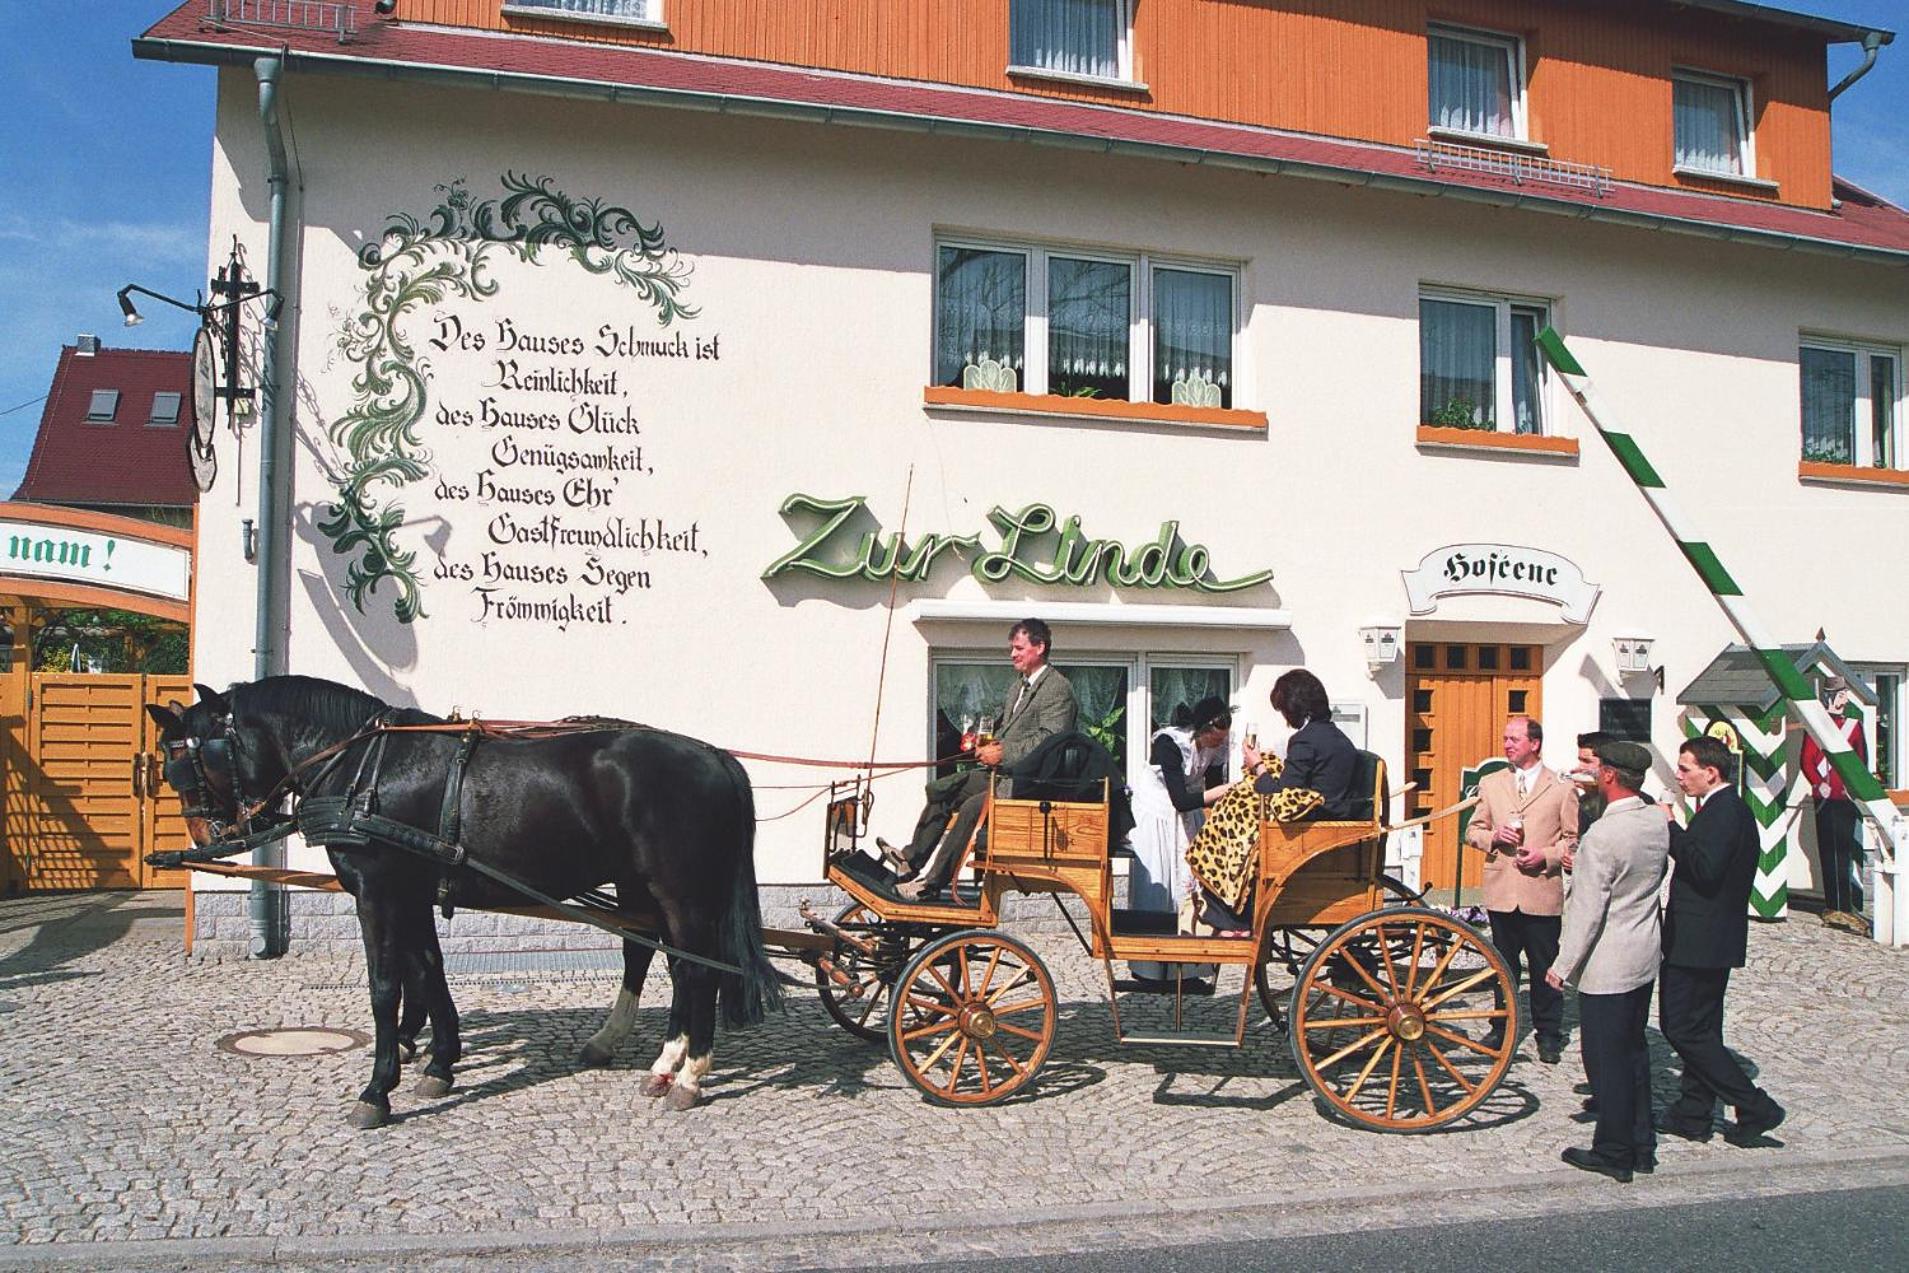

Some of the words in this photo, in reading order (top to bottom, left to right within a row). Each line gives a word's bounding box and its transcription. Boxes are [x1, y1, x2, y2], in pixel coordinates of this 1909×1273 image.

[429, 311, 486, 351] Des
[495, 318, 585, 355] Hauses
[594, 324, 690, 359] Schmuck
[695, 332, 720, 360] ist
[481, 359, 628, 400] Reinlichkeit,
[436, 400, 473, 427] des
[479, 397, 561, 431] Hauses
[568, 402, 640, 434] Glück
[434, 474, 470, 500] des
[476, 469, 556, 506] Hauses
[488, 512, 709, 558] Gastfreundlichkeit,
[761, 493, 982, 583] Zur
[970, 502, 1275, 593] Linde
[433, 556, 474, 581] des
[481, 551, 569, 584] Hauses
[578, 551, 652, 595] Segen
